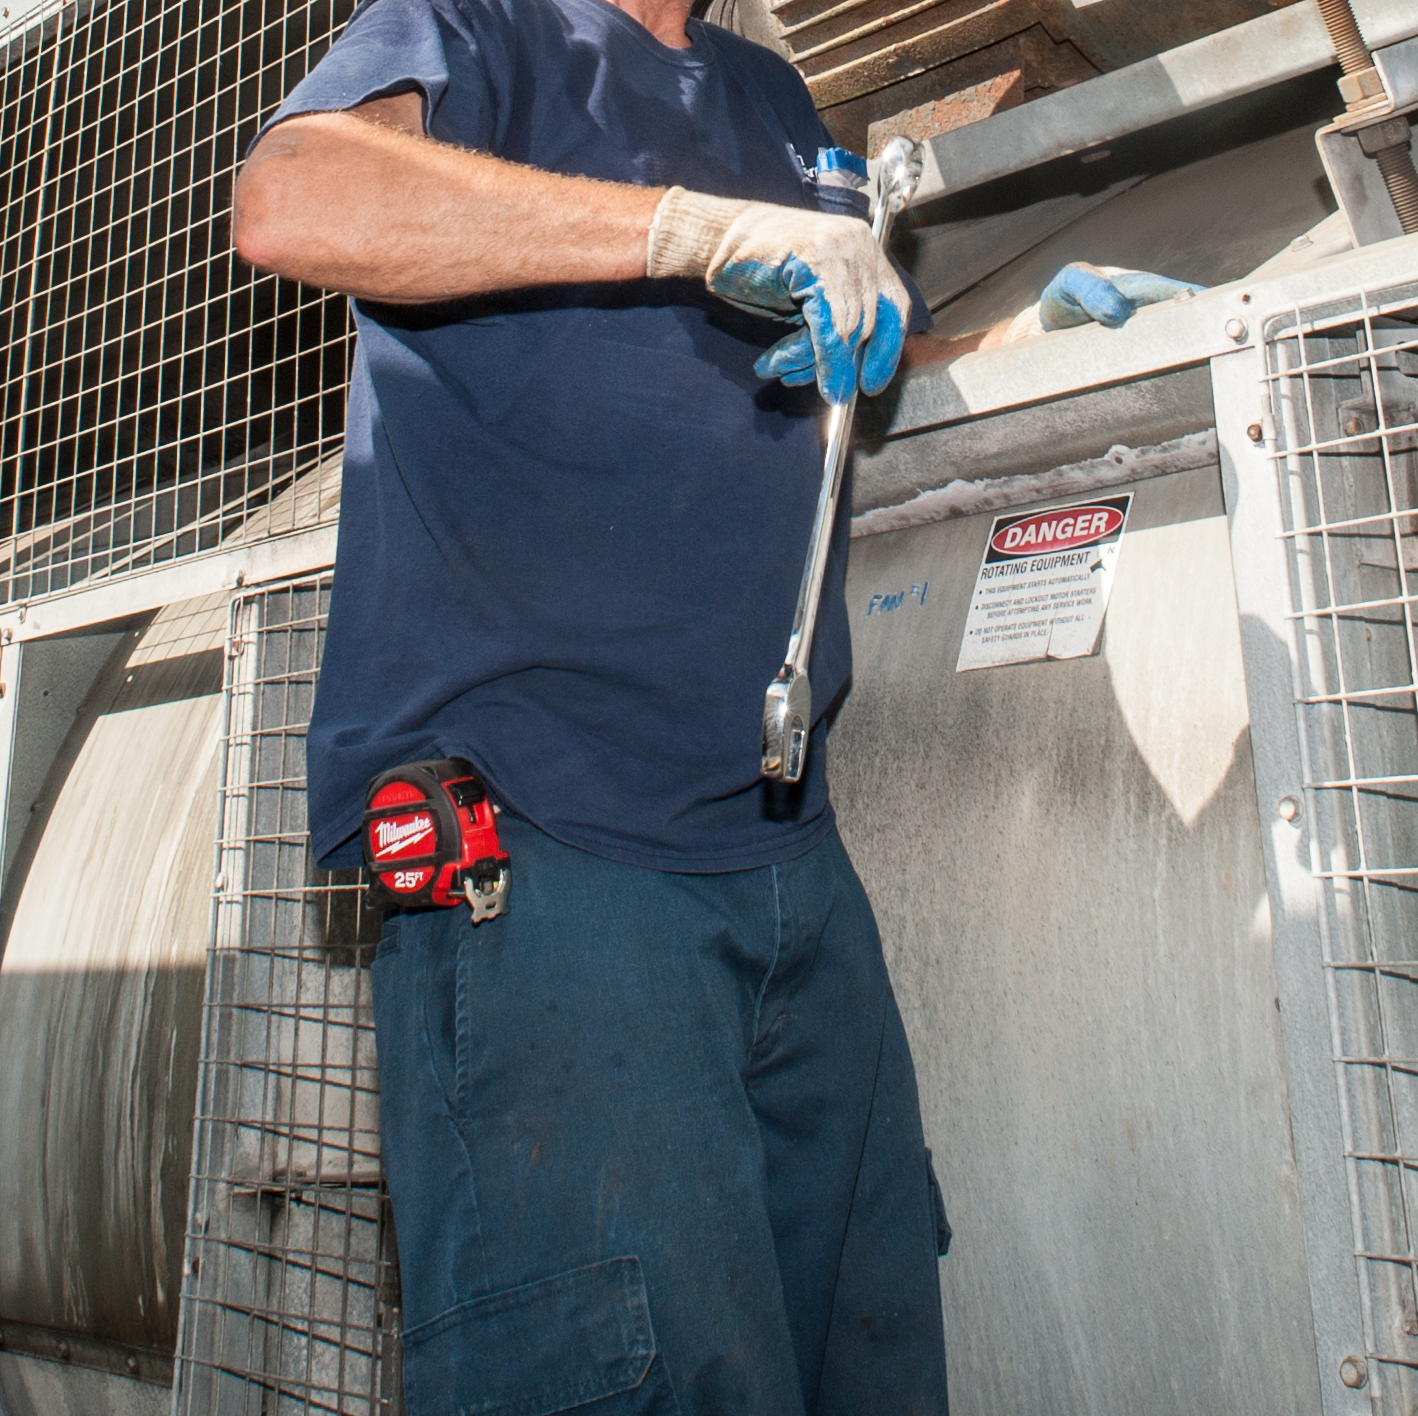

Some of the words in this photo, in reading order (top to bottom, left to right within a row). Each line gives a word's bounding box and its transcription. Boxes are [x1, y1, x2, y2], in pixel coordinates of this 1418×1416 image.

[1004, 512, 1109, 549] DANGER
[981, 564, 1027, 580] ROTATING
[1030, 551, 1091, 572] EQUIPMENT
[985, 587, 996, 595] THIS
[997, 582, 1027, 593] EQUIPMENT
[1027, 579, 1047, 589] STARTS
[1048, 573, 1090, 585] AUTOMATICALLY
[866, 591, 905, 618] FAN
[981, 599, 1012, 610] DISCONNECT
[1013, 597, 1024, 605] AND
[1025, 594, 1049, 605] LOCKOUT
[1050, 591, 1069, 601] MOTOR
[1070, 587, 1097, 597] STARTERS
[987, 610, 1006, 619] BEFORE
[1007, 605, 1040, 616] ATTEMPTING
[1040, 603, 1051, 611] ANY
[1052, 600, 1074, 609] SERVICE
[1076, 597, 1092, 606] WORK
[983, 626, 994, 634] NOT
[994, 622, 1017, 632] OPERATE
[1017, 619, 1048, 630] EQUIPMENT
[1049, 616, 1074, 625] WITHOUT
[1075, 614, 1084, 622] ALL
[981, 635, 1000, 644] SAFETY
[1001, 632, 1023, 642] GUARDS
[1030, 628, 1047, 637] PLACE
[375, 816, 431, 848] Milwaukee
